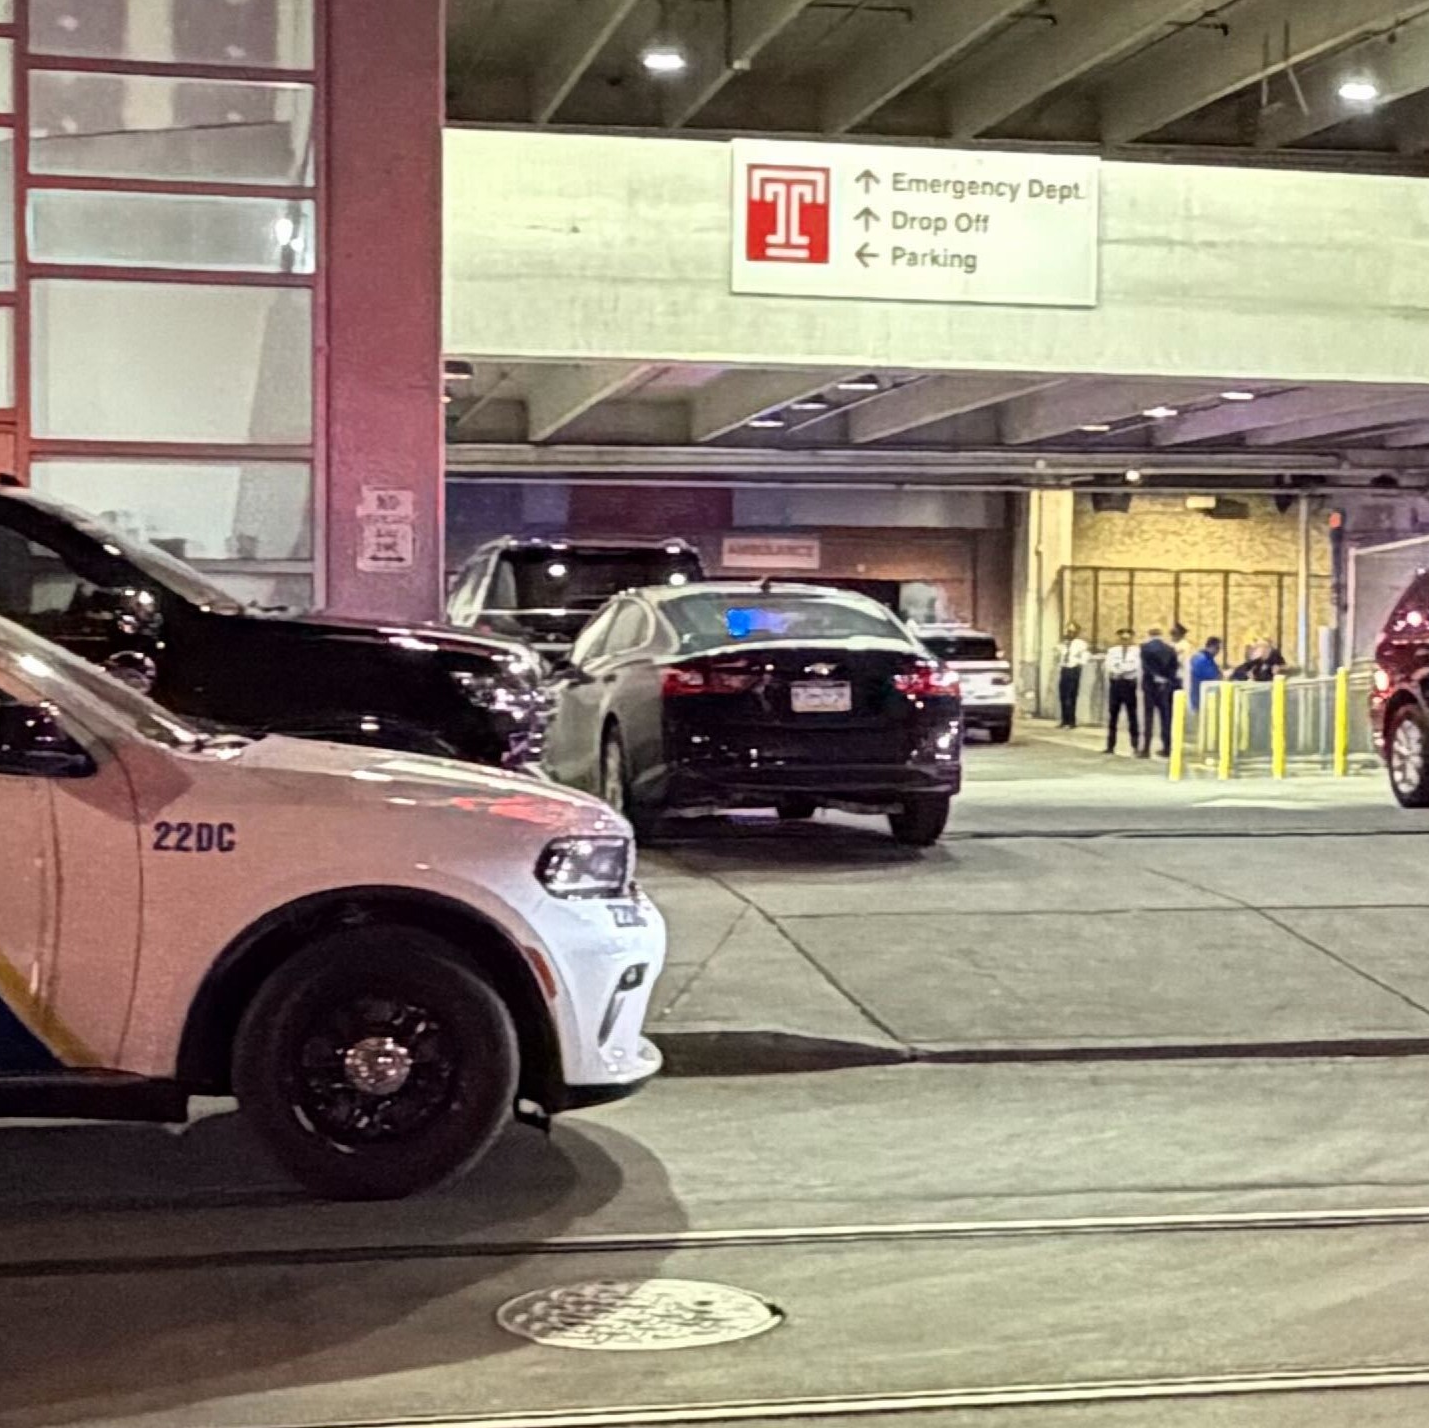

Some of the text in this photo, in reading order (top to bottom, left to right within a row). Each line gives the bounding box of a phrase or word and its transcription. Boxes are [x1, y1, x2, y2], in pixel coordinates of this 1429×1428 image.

[891, 173, 1087, 204] Emergency Dept.
[891, 211, 990, 234] Drop Off
[891, 245, 978, 273] Parking
[153, 820, 236, 852] 22DC
